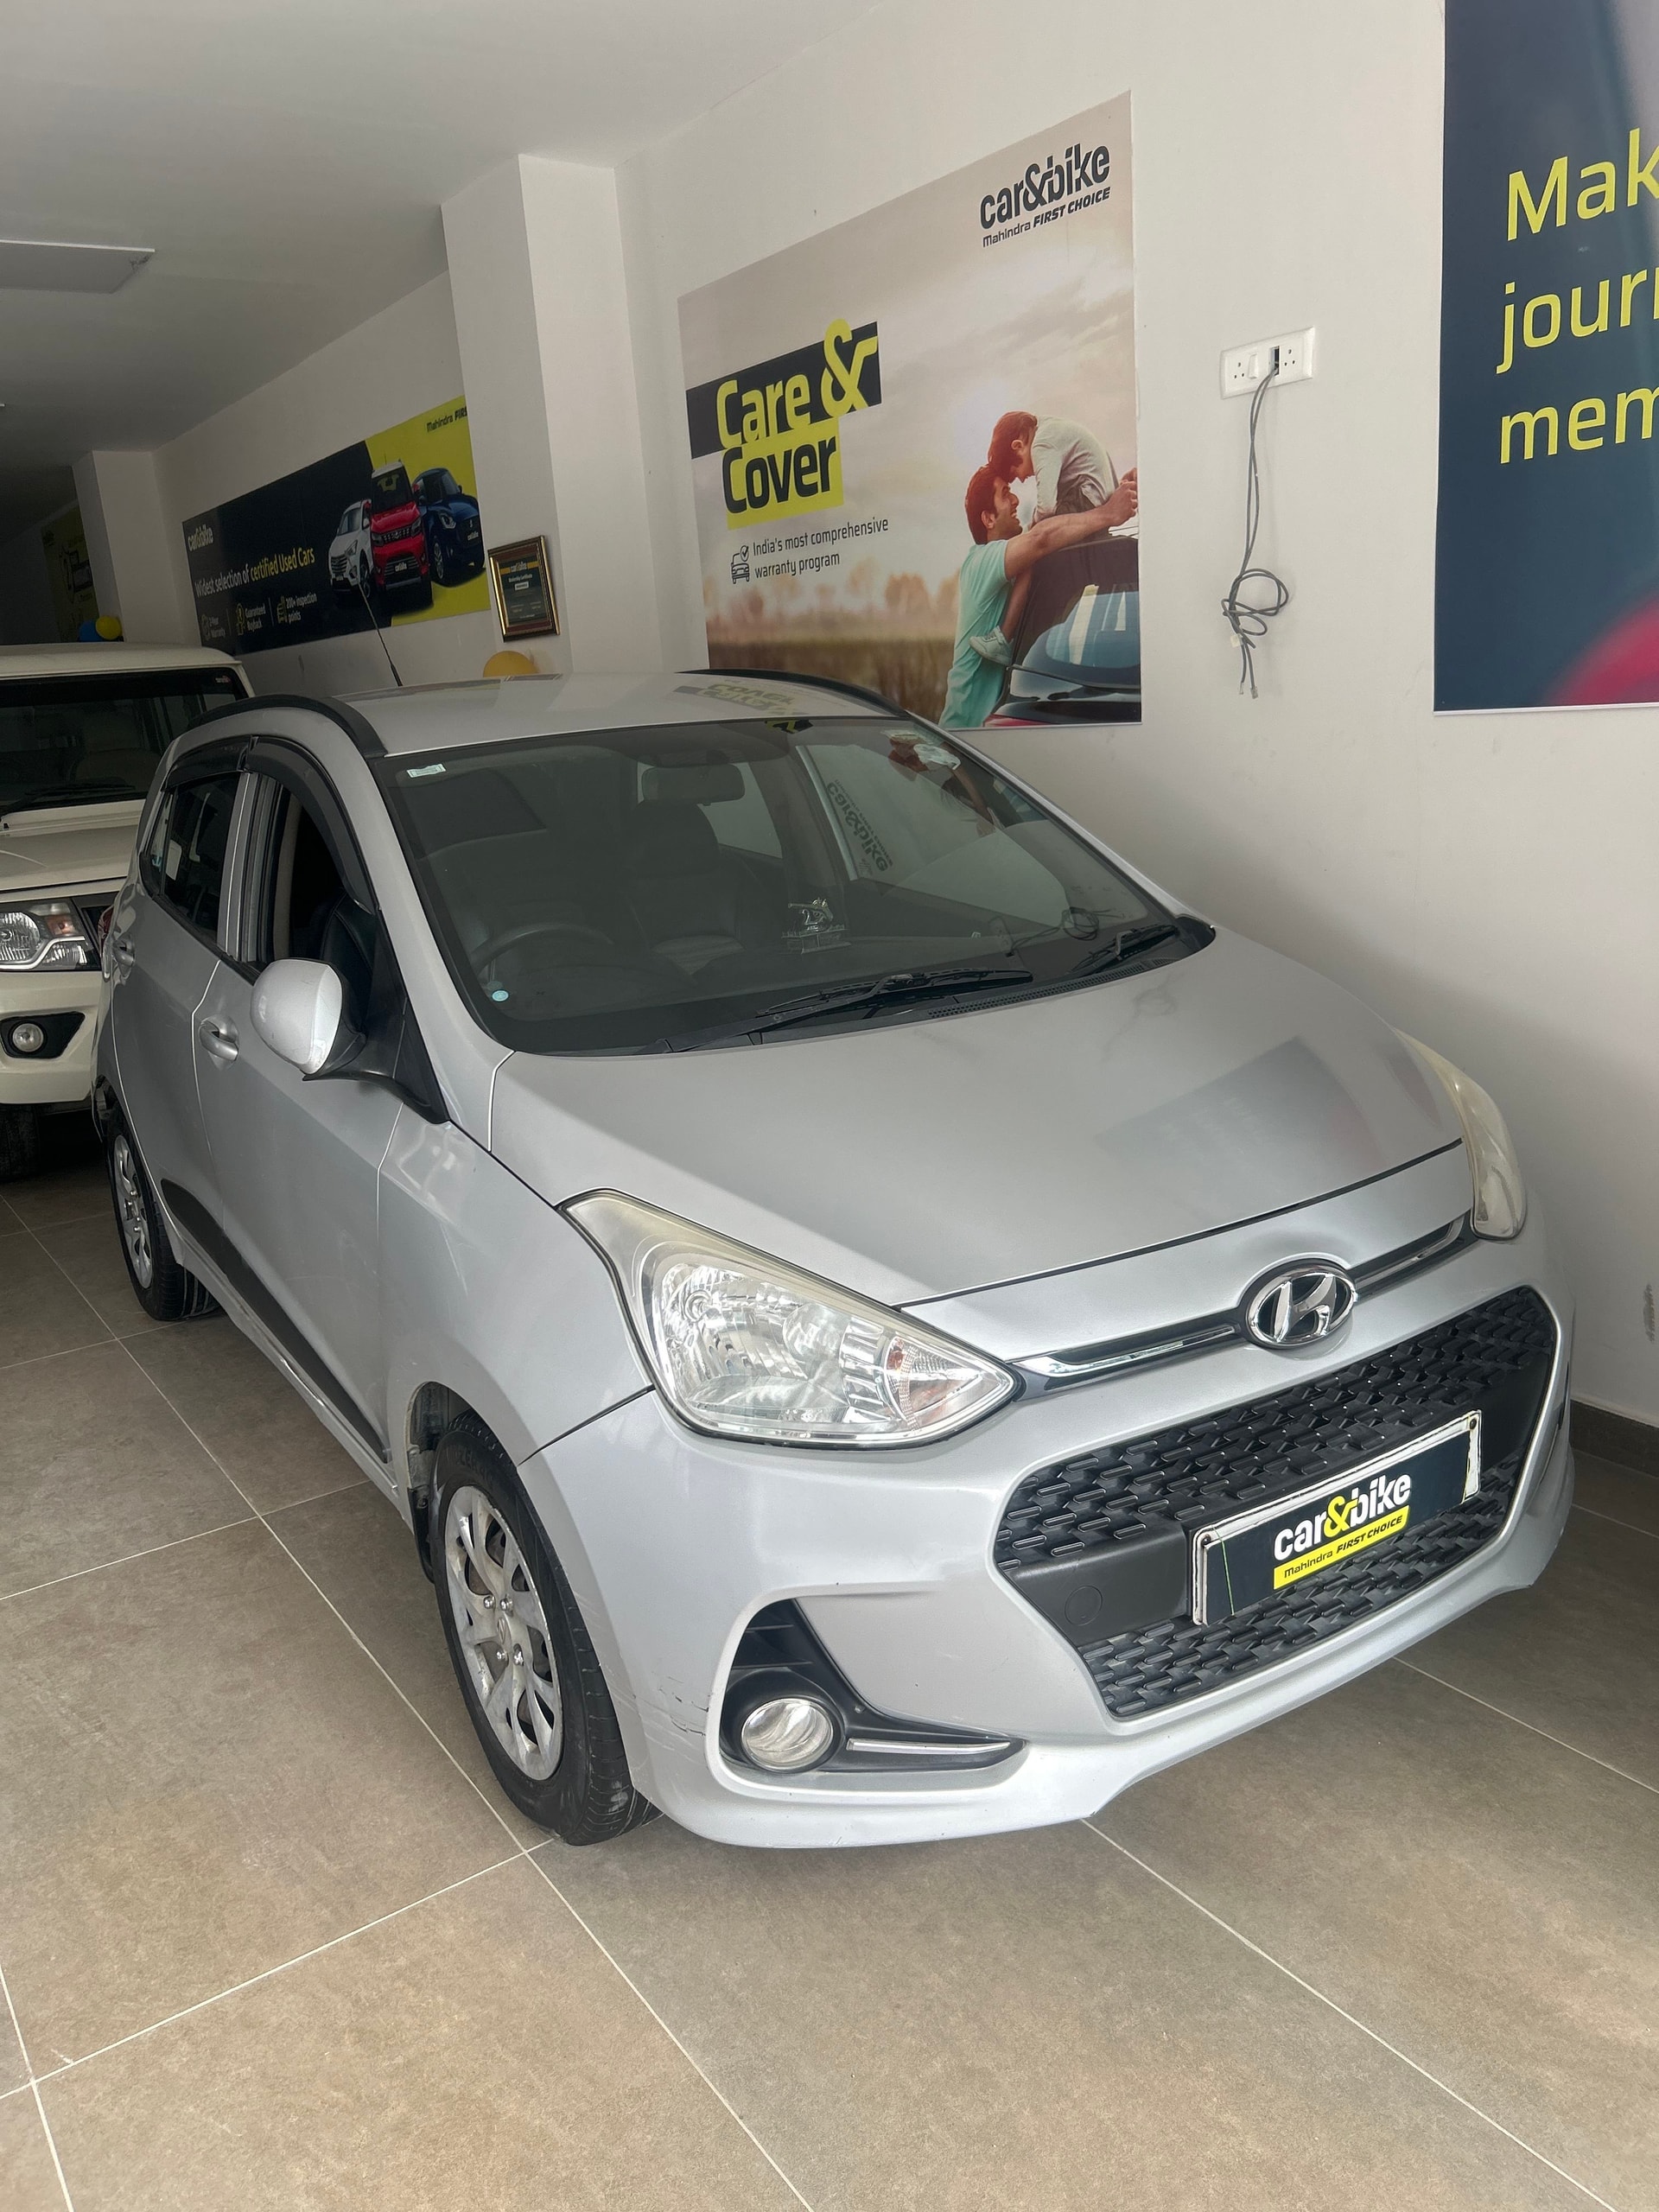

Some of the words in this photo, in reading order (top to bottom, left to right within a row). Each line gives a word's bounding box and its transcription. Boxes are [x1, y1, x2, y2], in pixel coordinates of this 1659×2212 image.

[980, 143, 1110, 230] car&bike
[982, 221, 1031, 248] Mahindra
[1033, 205, 1065, 228] FIRST
[1067, 187, 1110, 214] CHOICE
[1506, 127, 1659, 241] Mak
[1496, 266, 1659, 374] jour
[716, 372, 810, 449] Care
[820, 318, 878, 418] &
[1500, 385, 1659, 464] mem
[721, 435, 837, 514] Cover
[194, 577, 215, 597] Widest
[215, 569, 243, 592] selection
[243, 563, 251, 584] of
[251, 553, 279, 582] certified
[278, 548, 298, 573] Used
[297, 548, 315, 568] Cars
[753, 538, 783, 556] India's
[785, 532, 808, 550] most
[810, 517, 889, 545] comprehensive
[754, 559, 797, 579] warranty
[798, 552, 840, 575] program
[1274, 1474, 1411, 1560] car&bike
[1284, 1551, 1333, 1579] Mahindra
[1336, 1532, 1366, 1554] FIRST
[1367, 1515, 1403, 1539] CHOICE
